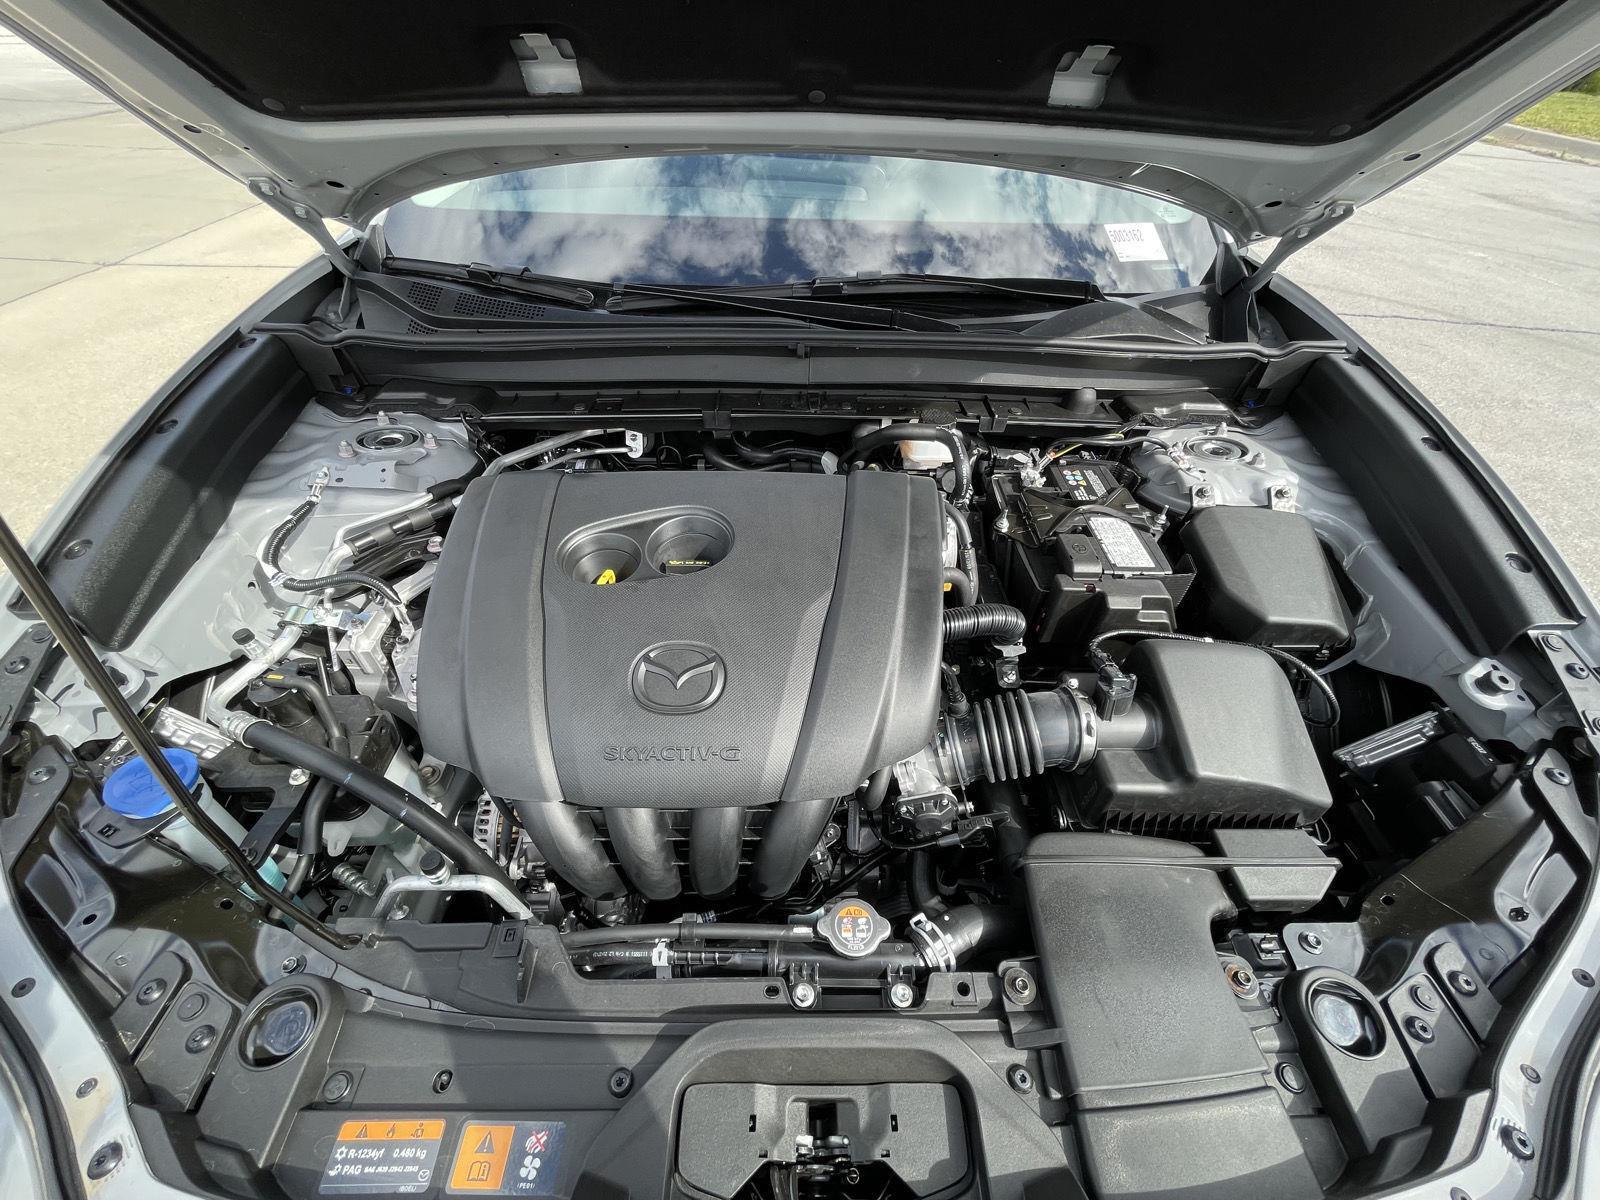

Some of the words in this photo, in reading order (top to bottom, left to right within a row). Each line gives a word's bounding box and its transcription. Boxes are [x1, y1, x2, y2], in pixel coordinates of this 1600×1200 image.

[603, 745, 741, 762] SKYACTIV-G
[347, 1148, 386, 1161] R-1234yf
[415, 1147, 428, 1160] kg
[342, 1165, 362, 1176] PAG
